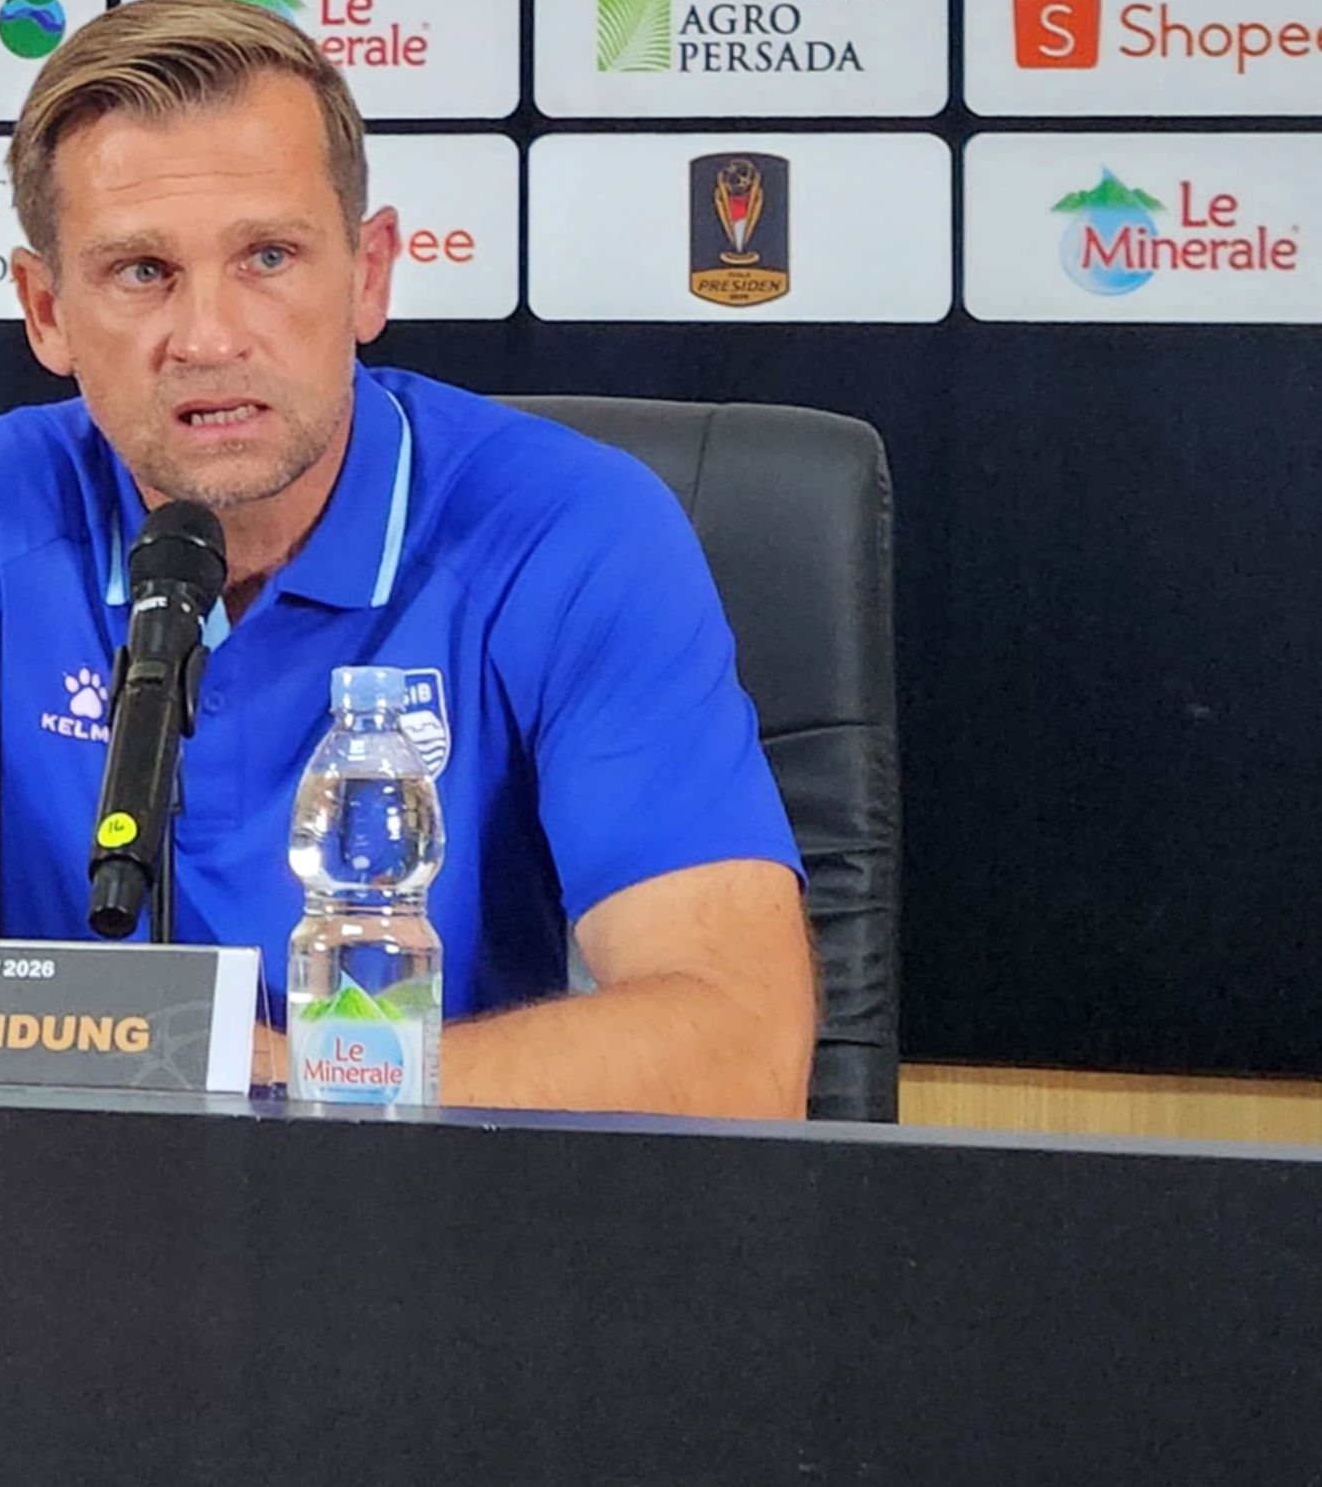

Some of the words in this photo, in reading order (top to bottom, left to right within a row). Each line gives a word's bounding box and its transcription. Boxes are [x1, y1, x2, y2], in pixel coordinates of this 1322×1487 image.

[679, 3, 802, 35] AGRO
[319, 22, 428, 66] erale
[1119, 2, 1322, 74] Shope
[678, 41, 865, 73] PERSADA
[1179, 182, 1237, 228] Le
[1080, 224, 1297, 272] Minerale
[40, 711, 110, 745] KELM
[3, 958, 55, 979] 2026
[335, 1037, 364, 1062] Le
[304, 1059, 403, 1084] Minerale
